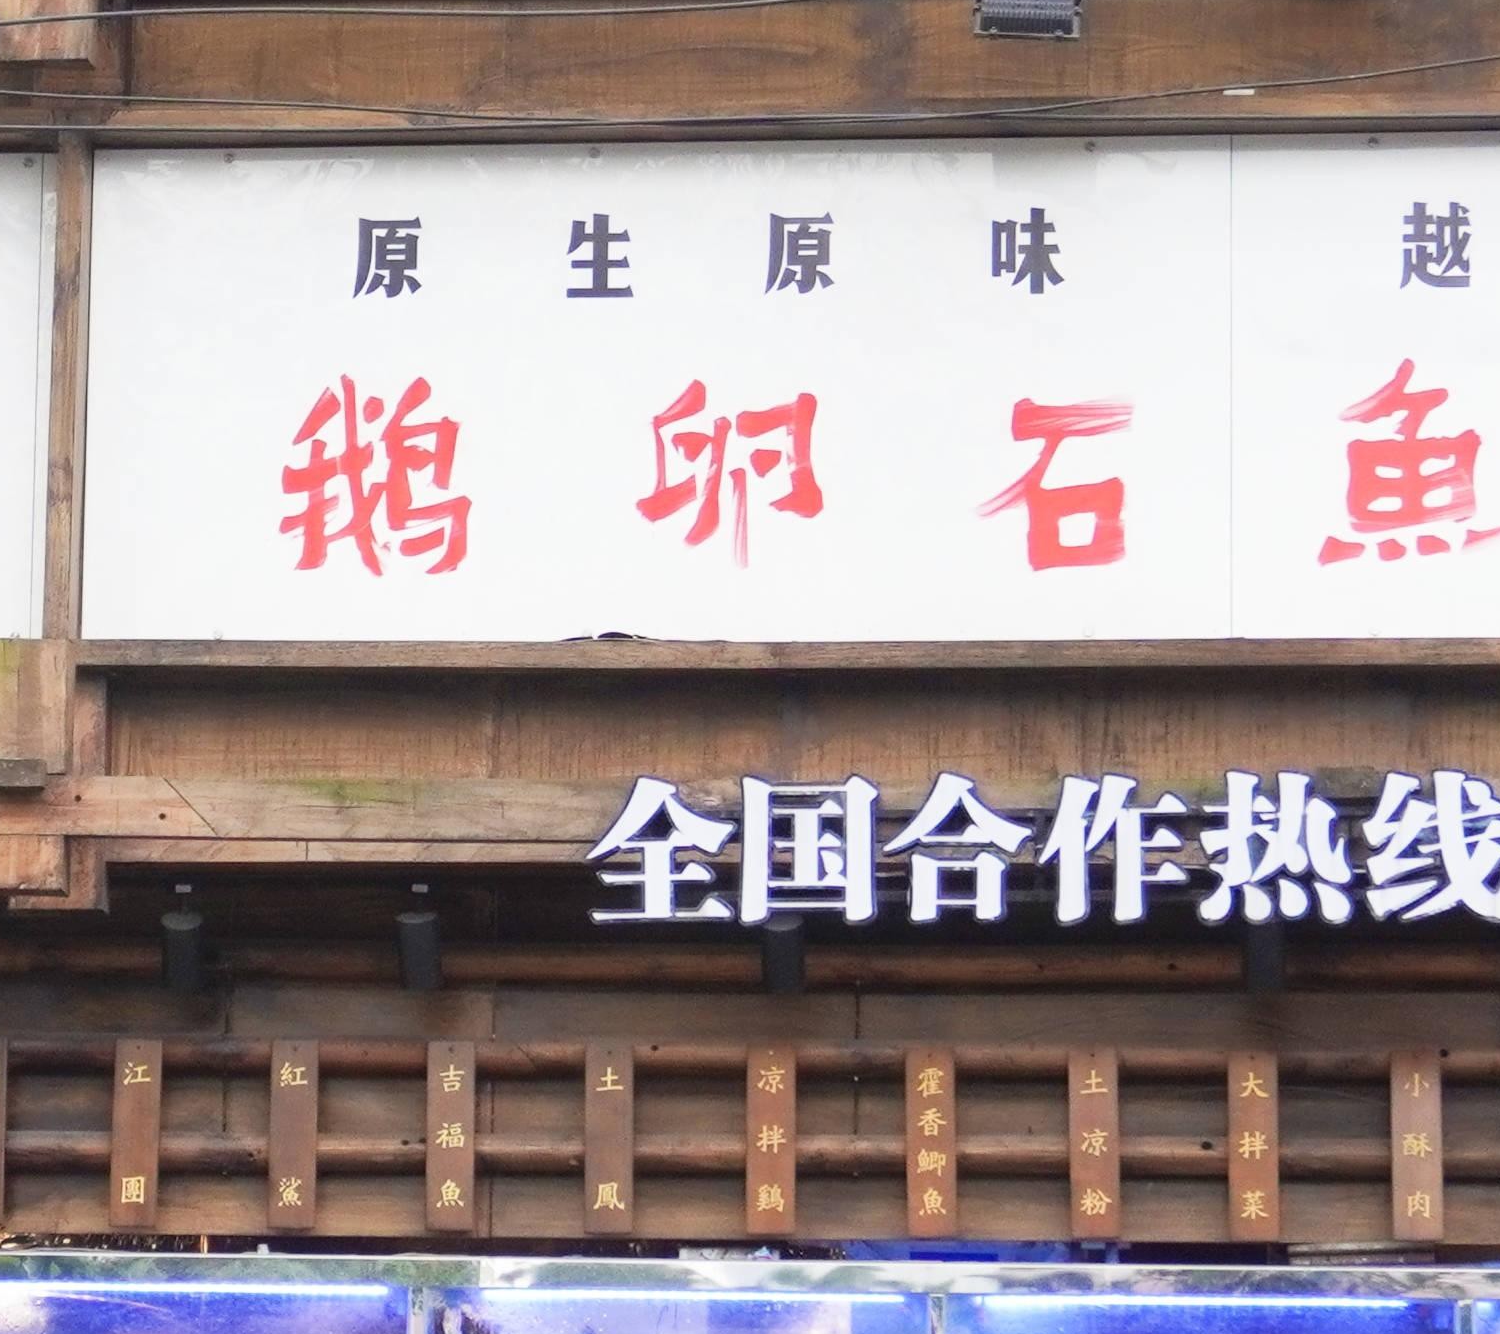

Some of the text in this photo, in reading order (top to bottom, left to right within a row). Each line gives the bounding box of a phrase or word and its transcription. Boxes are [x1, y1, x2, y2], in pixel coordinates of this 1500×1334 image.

[353, 207, 1066, 299] 原生原味
[276, 1062, 308, 1207] 紅鯊
[435, 1064, 466, 1209] 吉福魚
[593, 1067, 625, 1211] 土鳳
[1238, 1072, 1270, 1219] 大拌菜
[1402, 1074, 1433, 1219] 小酥肉
